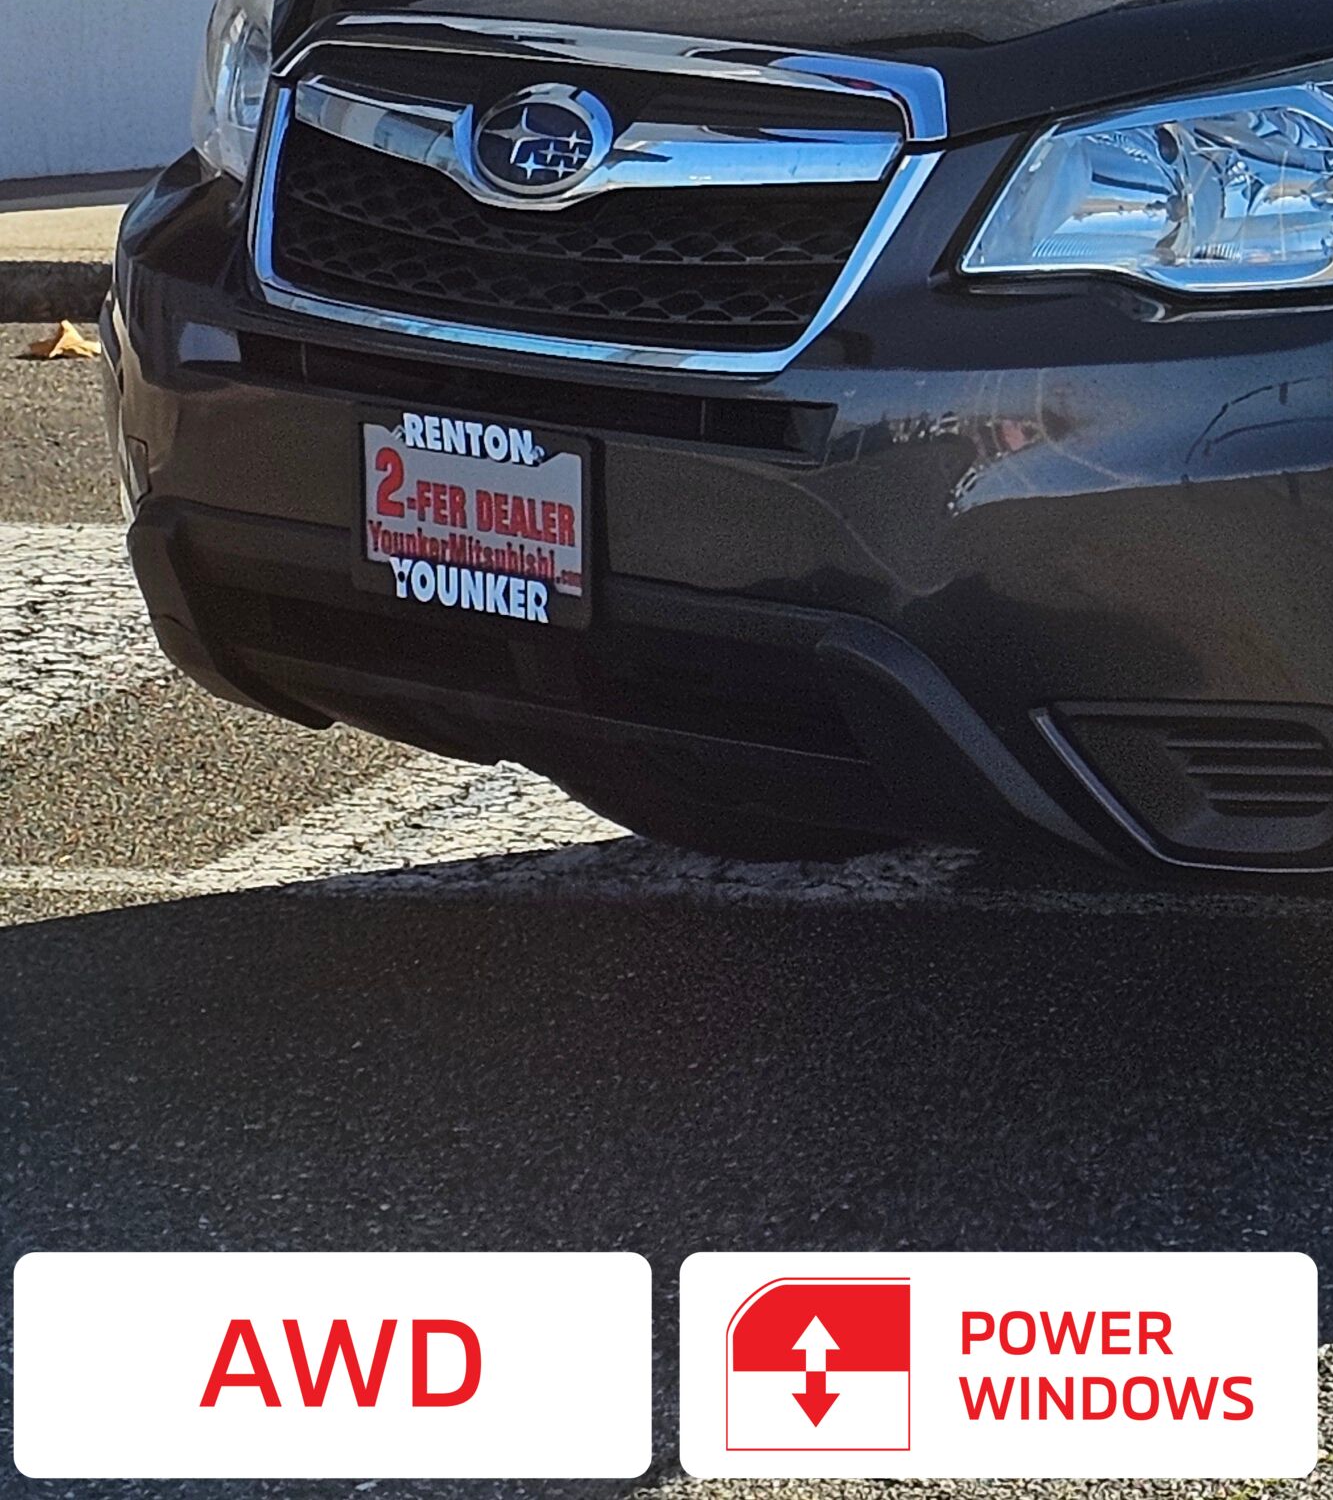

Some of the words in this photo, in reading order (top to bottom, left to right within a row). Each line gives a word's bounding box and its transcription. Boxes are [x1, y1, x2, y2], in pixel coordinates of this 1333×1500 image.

[403, 412, 534, 466] RENTON
[375, 446, 468, 529] 2-FER
[476, 489, 576, 547] DEALER
[389, 556, 549, 624] YOUNKER
